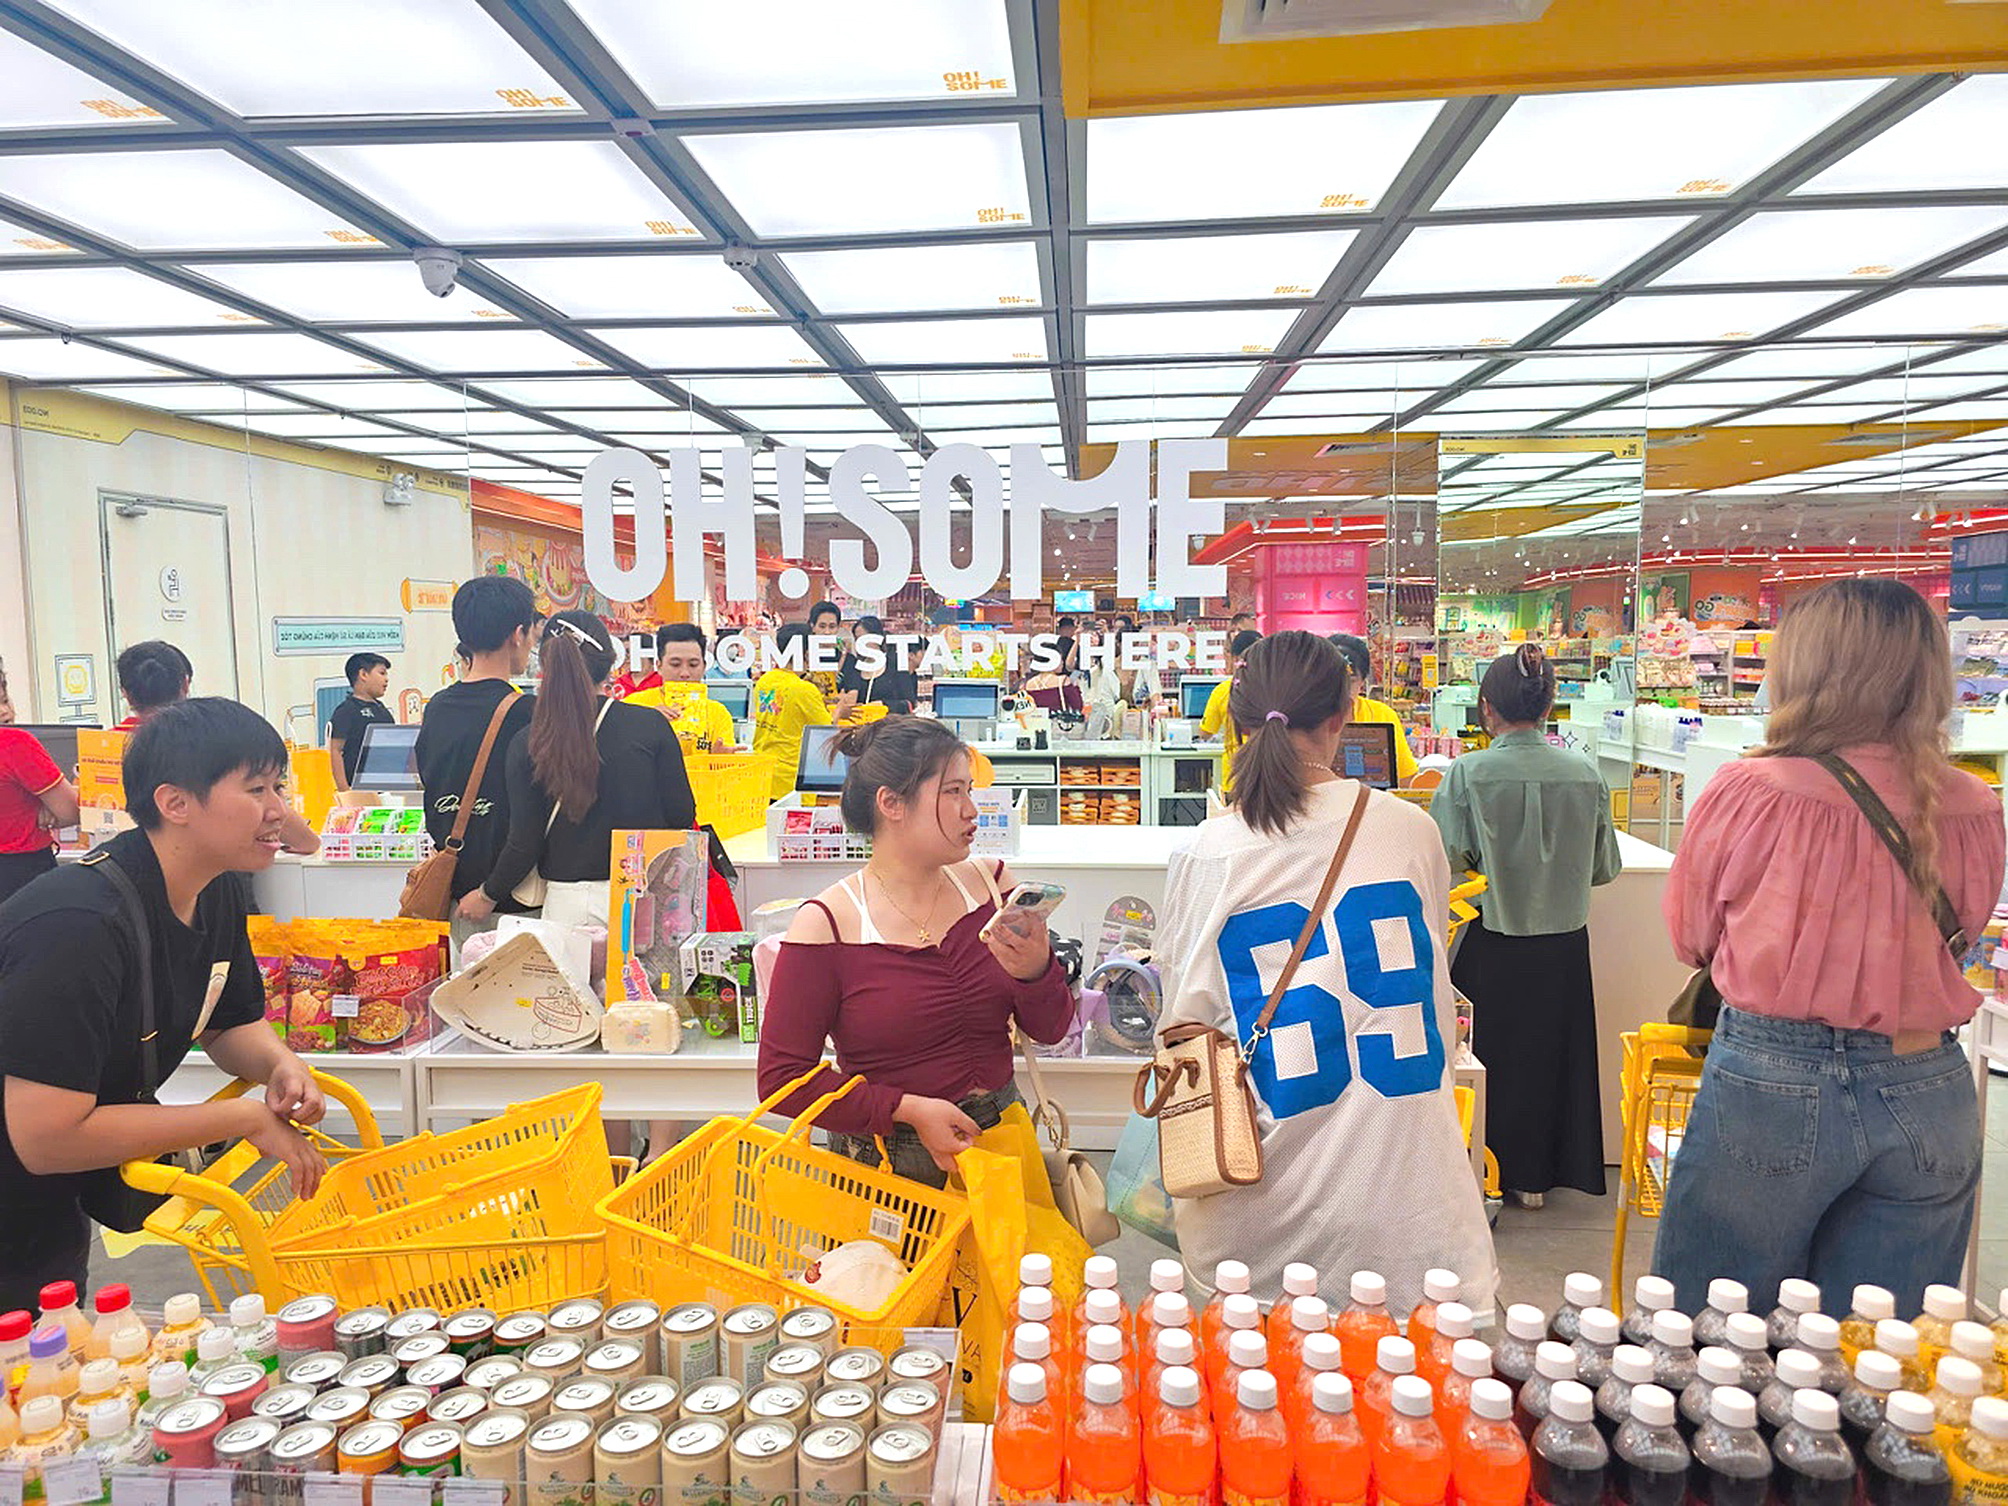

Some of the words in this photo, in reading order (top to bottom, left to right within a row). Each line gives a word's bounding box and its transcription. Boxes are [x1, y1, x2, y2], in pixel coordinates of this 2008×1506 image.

[943, 71, 979, 82] OH!
[947, 79, 1007, 91] SOME
[496, 88, 531, 98] OH!
[507, 96, 571, 107] SOME
[1323, 193, 1352, 201] OH!
[977, 208, 1005, 216] OH!
[979, 213, 1025, 222] SOME
[581, 438, 1229, 603] OH!SOME
[853, 632, 1062, 673] STARTS
[1079, 632, 1227, 672] HERE
[1217, 878, 1446, 1121] 69
